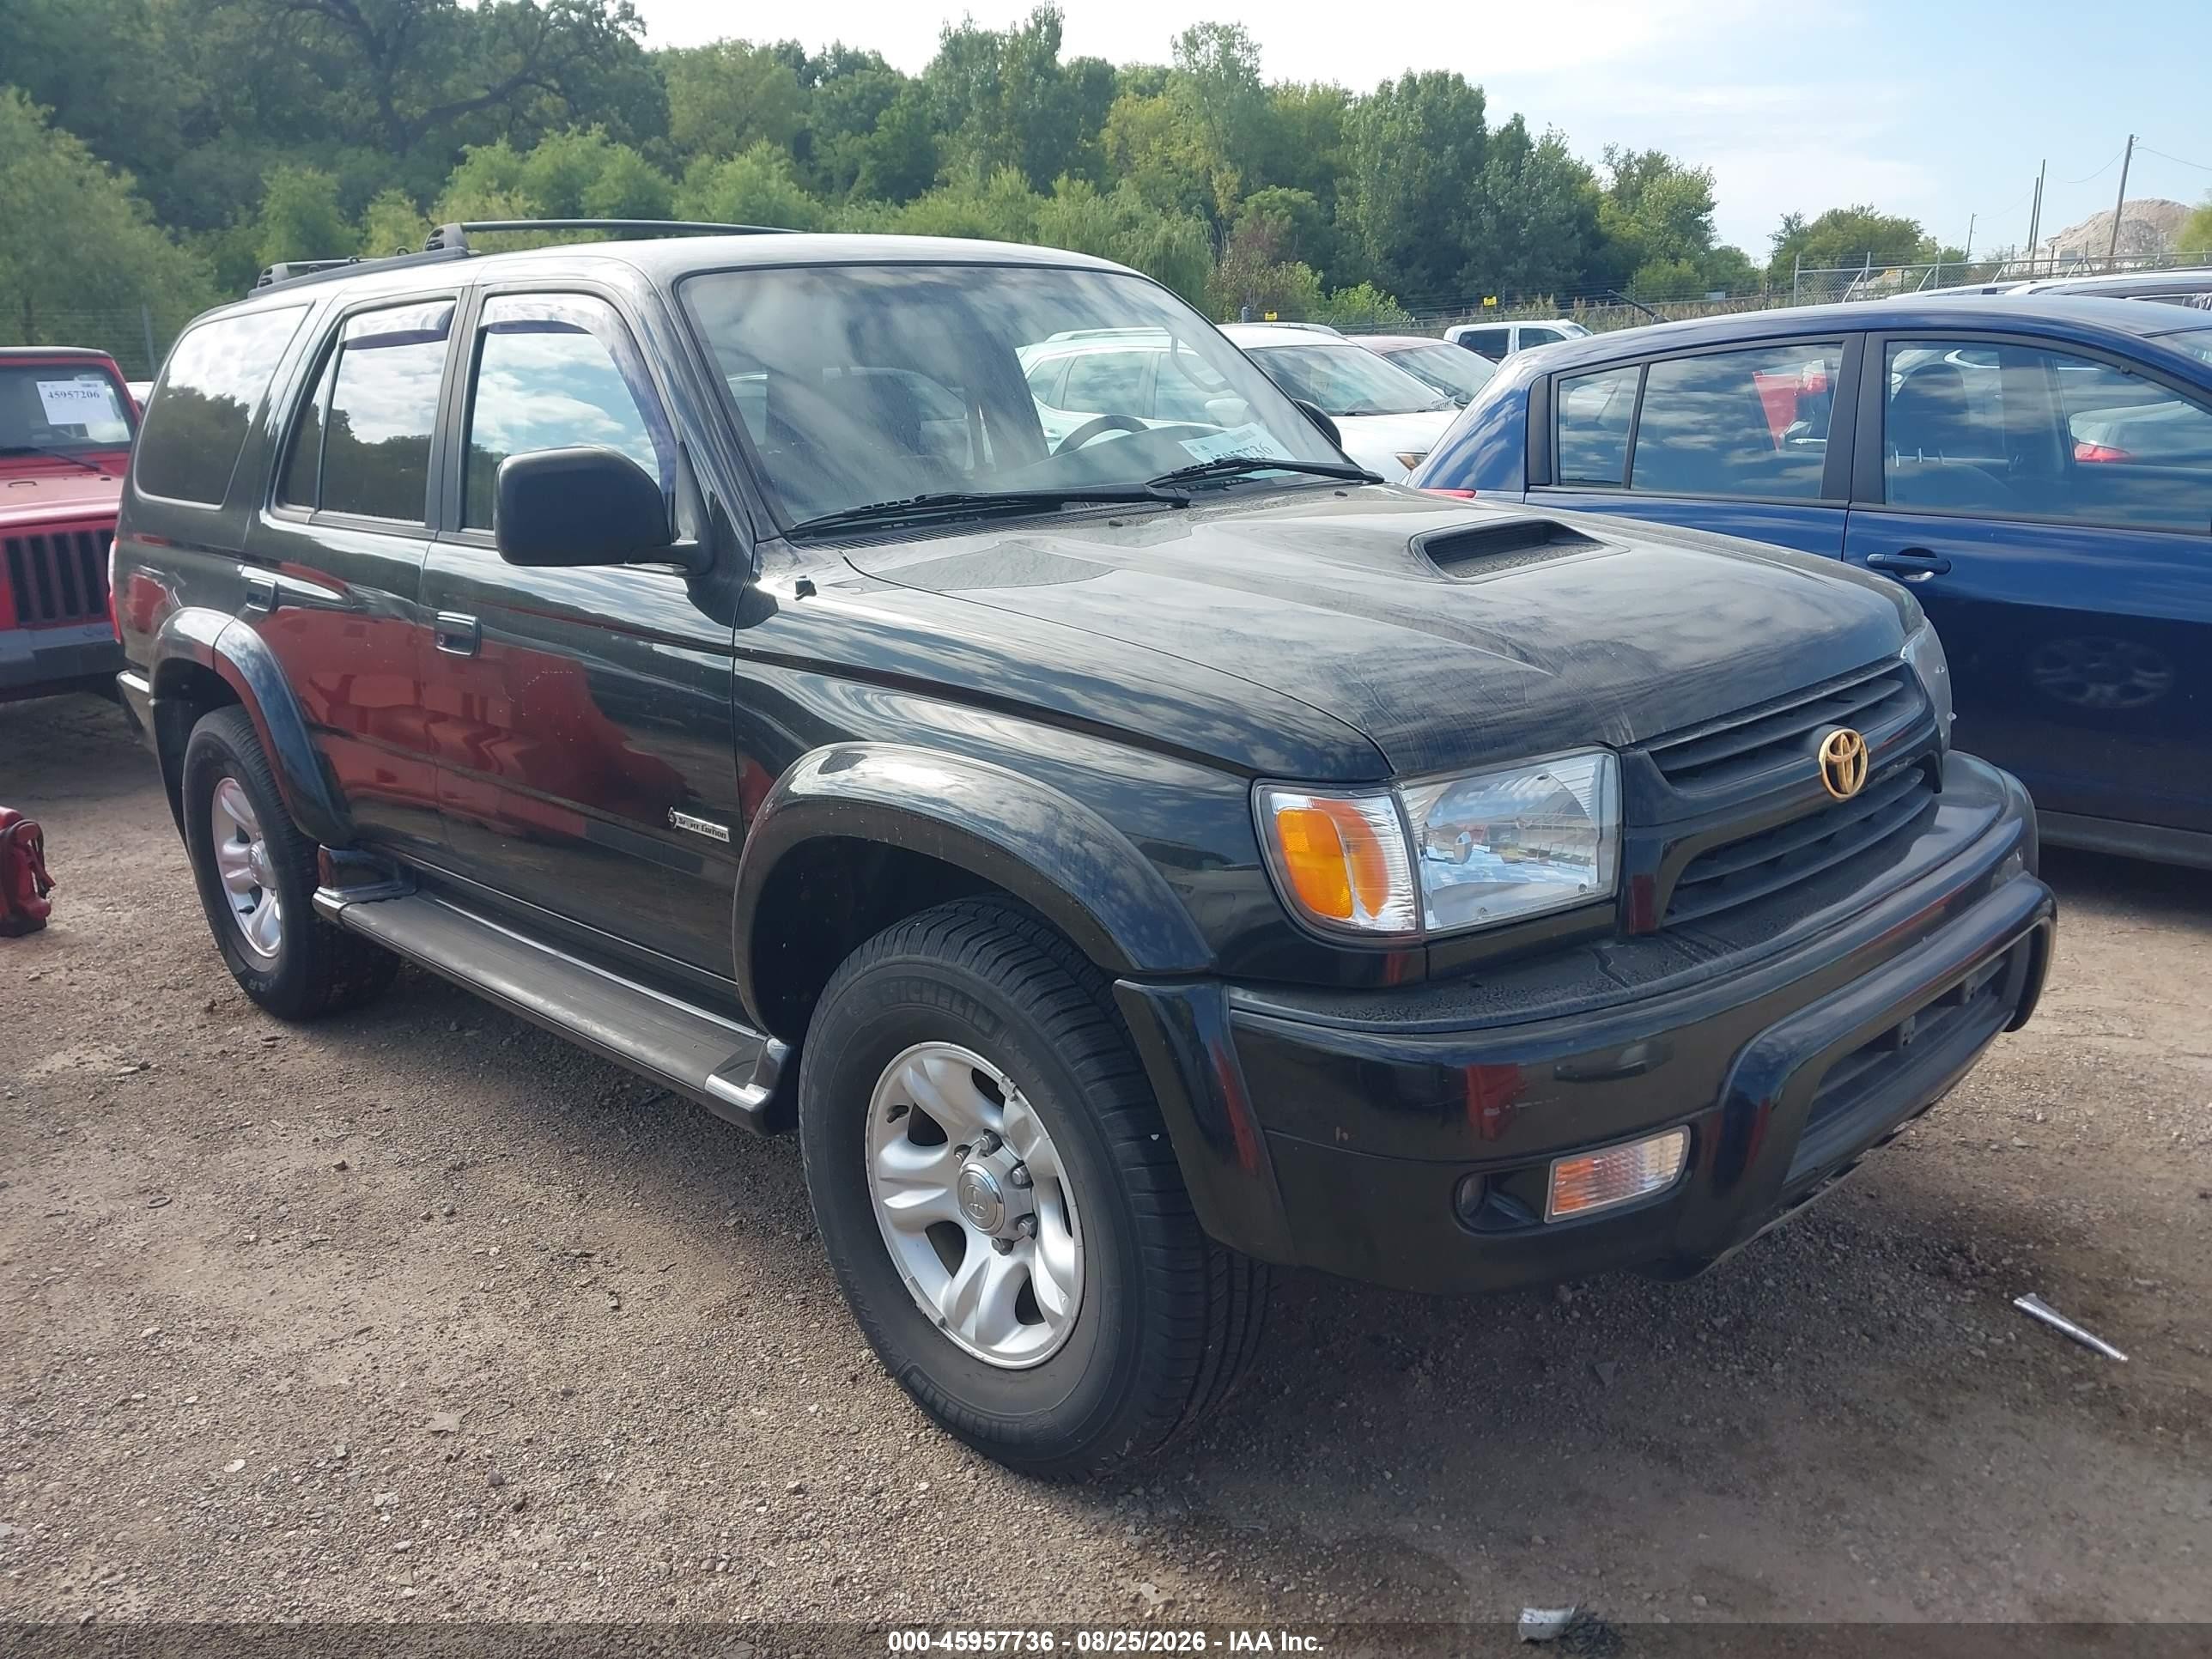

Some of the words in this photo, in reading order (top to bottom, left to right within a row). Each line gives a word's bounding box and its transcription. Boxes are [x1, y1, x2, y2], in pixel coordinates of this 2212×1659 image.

[47, 390, 100, 398] 45957206
[1210, 441, 1273, 458] 97736
[878, 978, 999, 1036] MICHELIN
[907, 1371, 1022, 1443] MICHELIN
